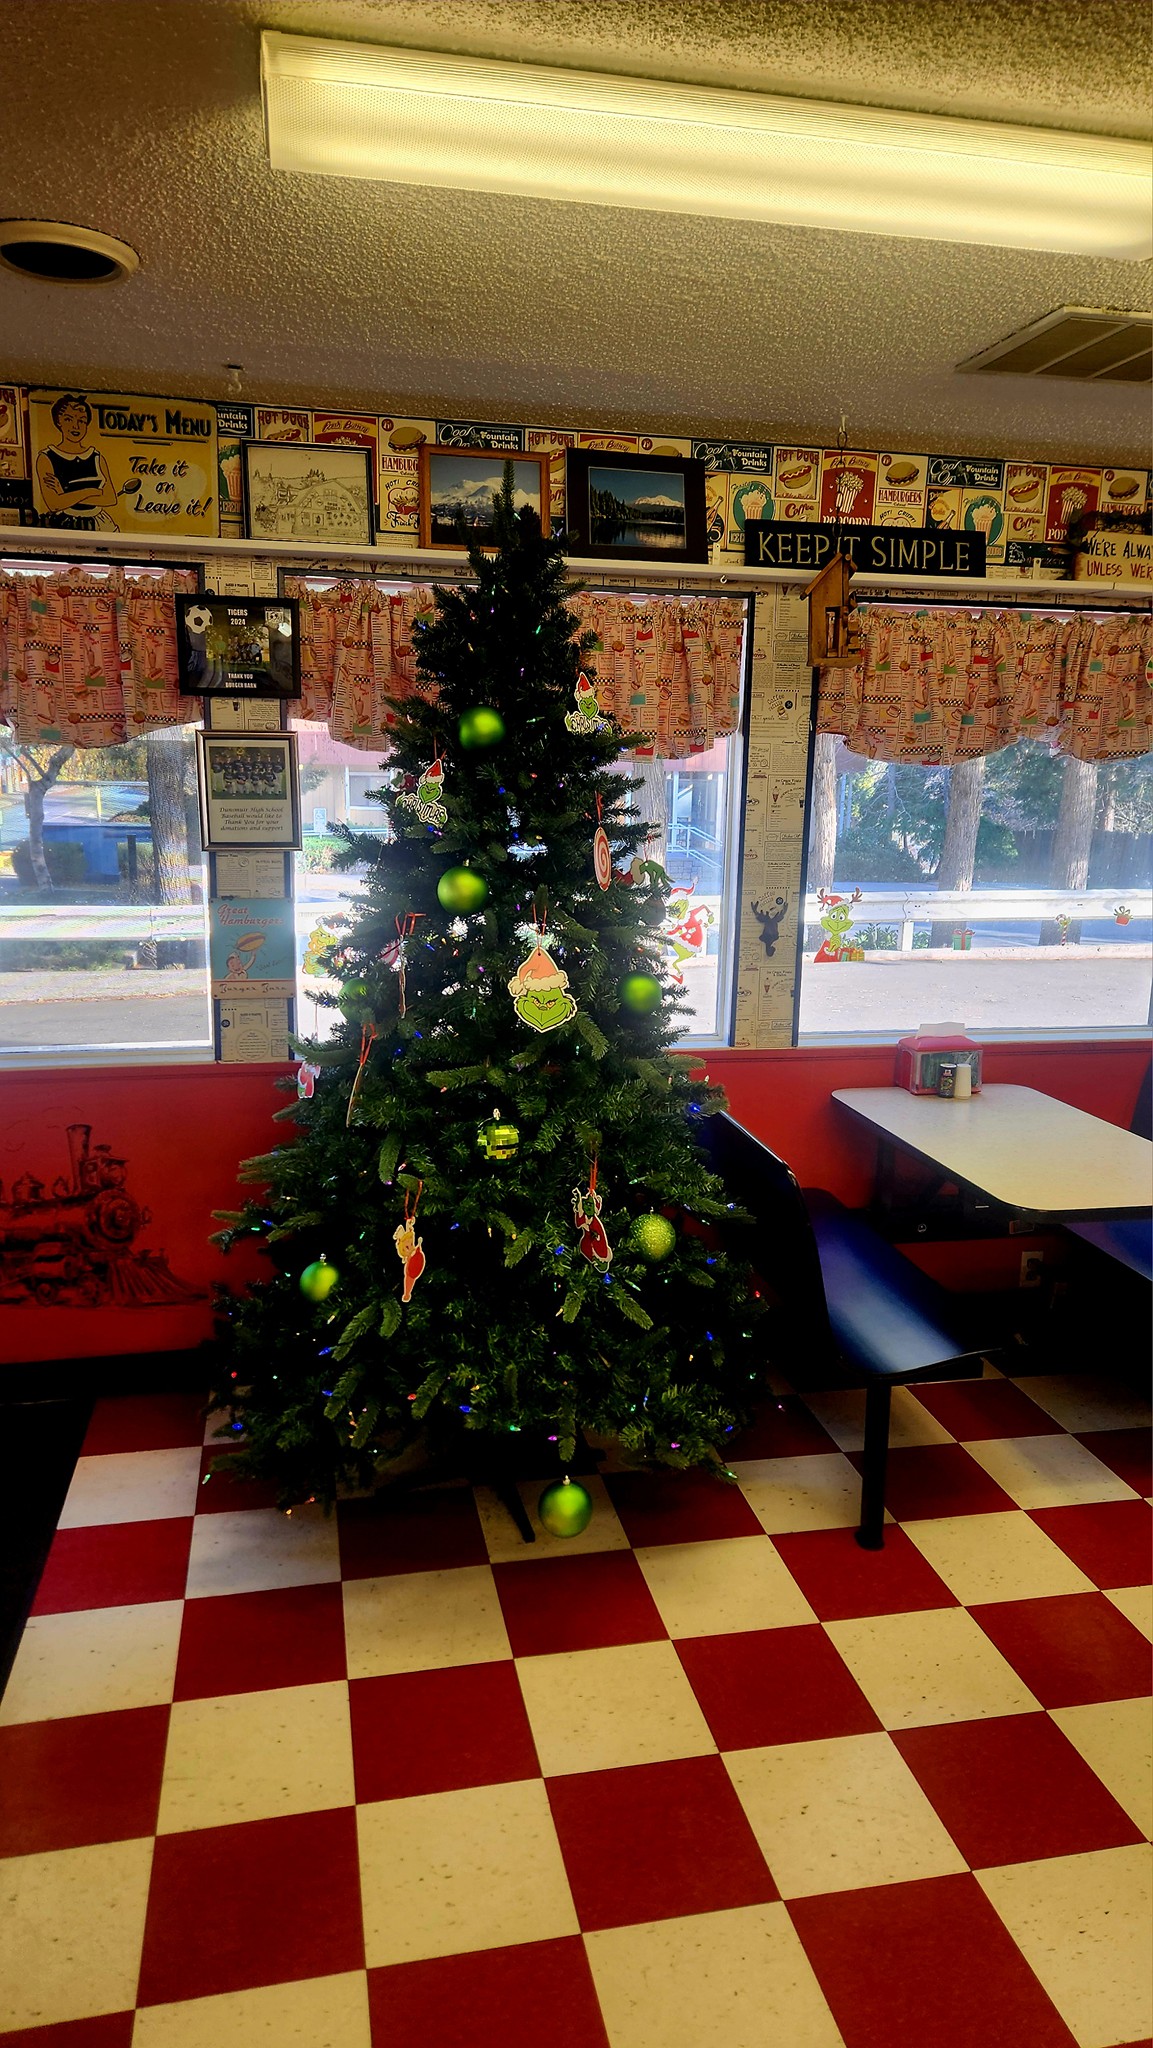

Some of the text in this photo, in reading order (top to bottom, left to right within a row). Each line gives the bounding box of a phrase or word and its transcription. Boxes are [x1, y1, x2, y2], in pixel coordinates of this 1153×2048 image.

[93, 404, 211, 436] TODAY'S MENU
[218, 412, 248, 421] untain
[257, 411, 279, 425] HOT
[440, 424, 477, 443] Cool
[480, 431, 519, 441] Fountain
[528, 432, 547, 446] HOT
[491, 440, 519, 450] Drinks
[695, 443, 728, 460] Cool
[731, 449, 768, 459] Fountain
[776, 450, 793, 463] HOT
[128, 456, 190, 477] Take it
[382, 456, 419, 471] HAMBURG
[741, 458, 768, 467] Drinks
[931, 459, 962, 476] Cool
[966, 464, 999, 474] Fountain
[974, 473, 998, 482] Drinks
[156, 482, 175, 494] or
[878, 489, 922, 504] HAMBURGERS
[133, 494, 213, 517] Leave it!
[785, 503, 815, 519] Coffee
[1013, 517, 1041, 531] Coffee
[757, 531, 830, 565] KEEP
[871, 535, 970, 571] SIMPLE
[1087, 560, 1122, 577] UNLESS
[227, 608, 248, 616] TIGERS
[217, 903, 248, 917] Great
[219, 983, 257, 993] Burger
